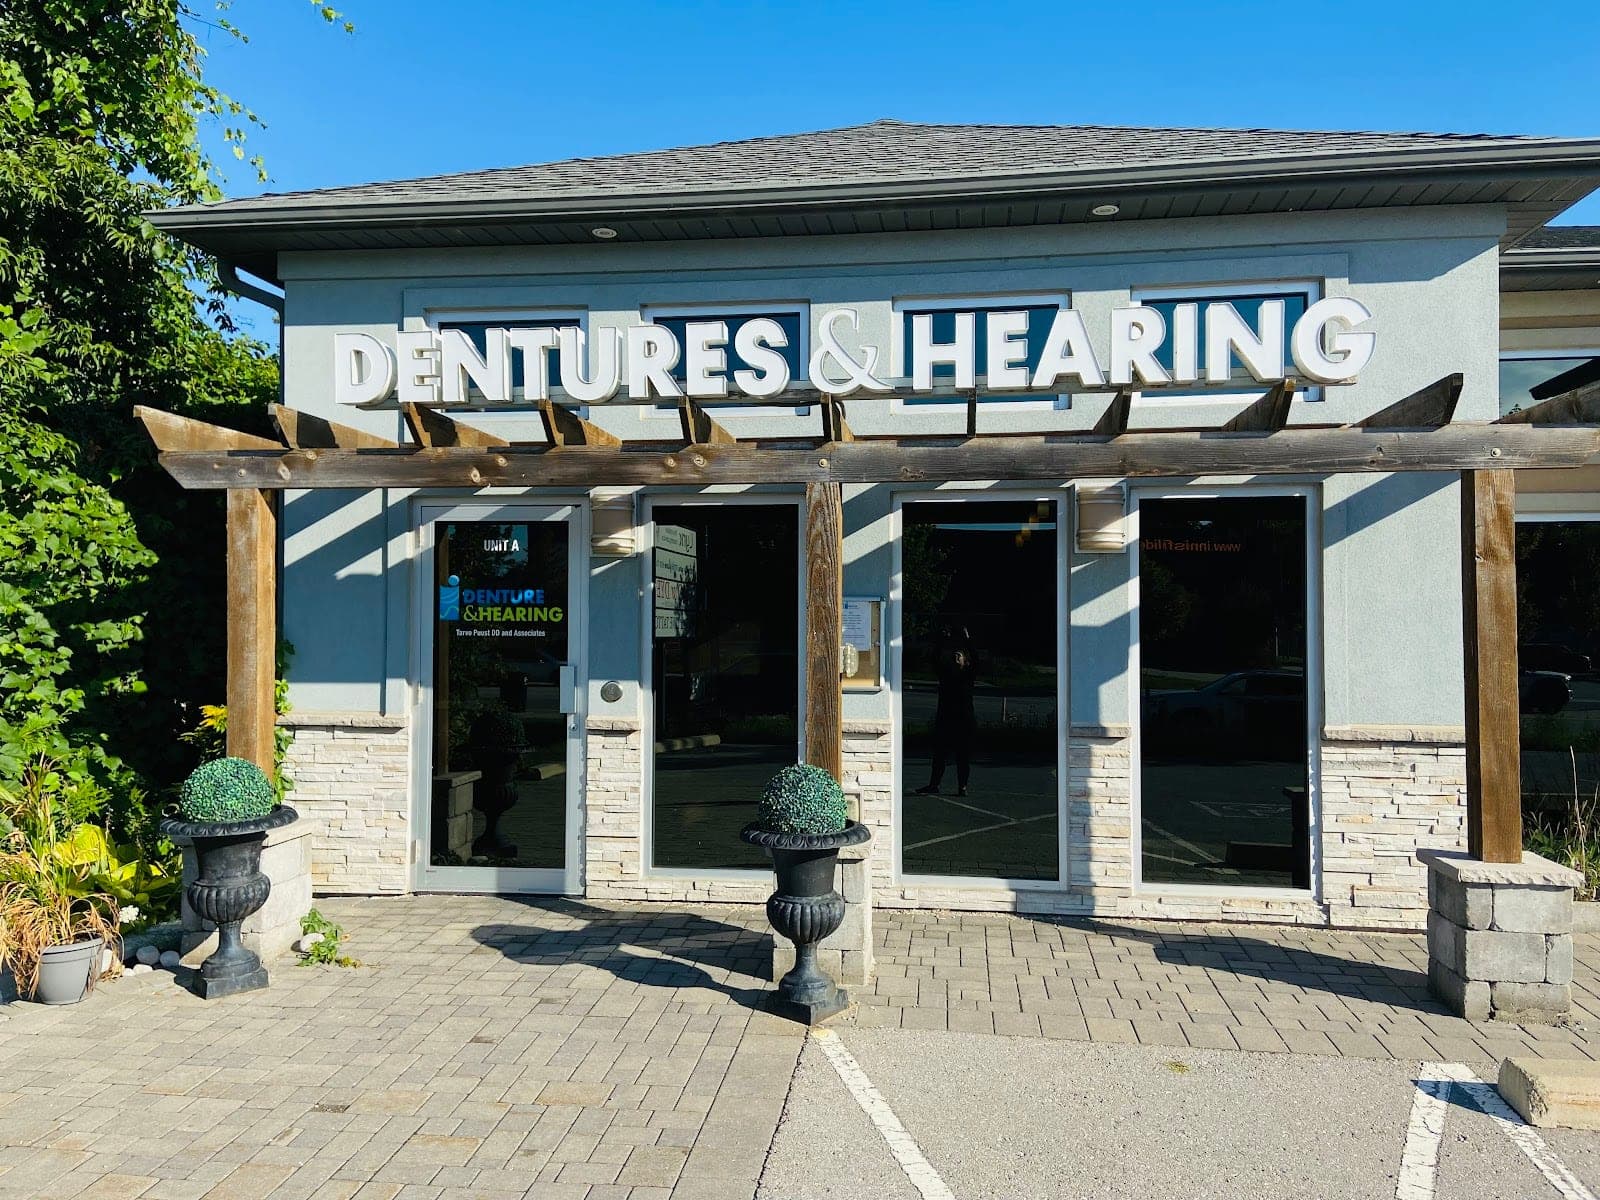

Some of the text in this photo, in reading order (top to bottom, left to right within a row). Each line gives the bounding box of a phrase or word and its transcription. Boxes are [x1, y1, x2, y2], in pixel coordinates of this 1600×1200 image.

[334, 296, 1377, 404] DENTURES & HEARING
[483, 539, 520, 552] UNIT A
[462, 588, 545, 604] DENTURE
[501, 628, 513, 637] and
[513, 628, 546, 637] Associates
